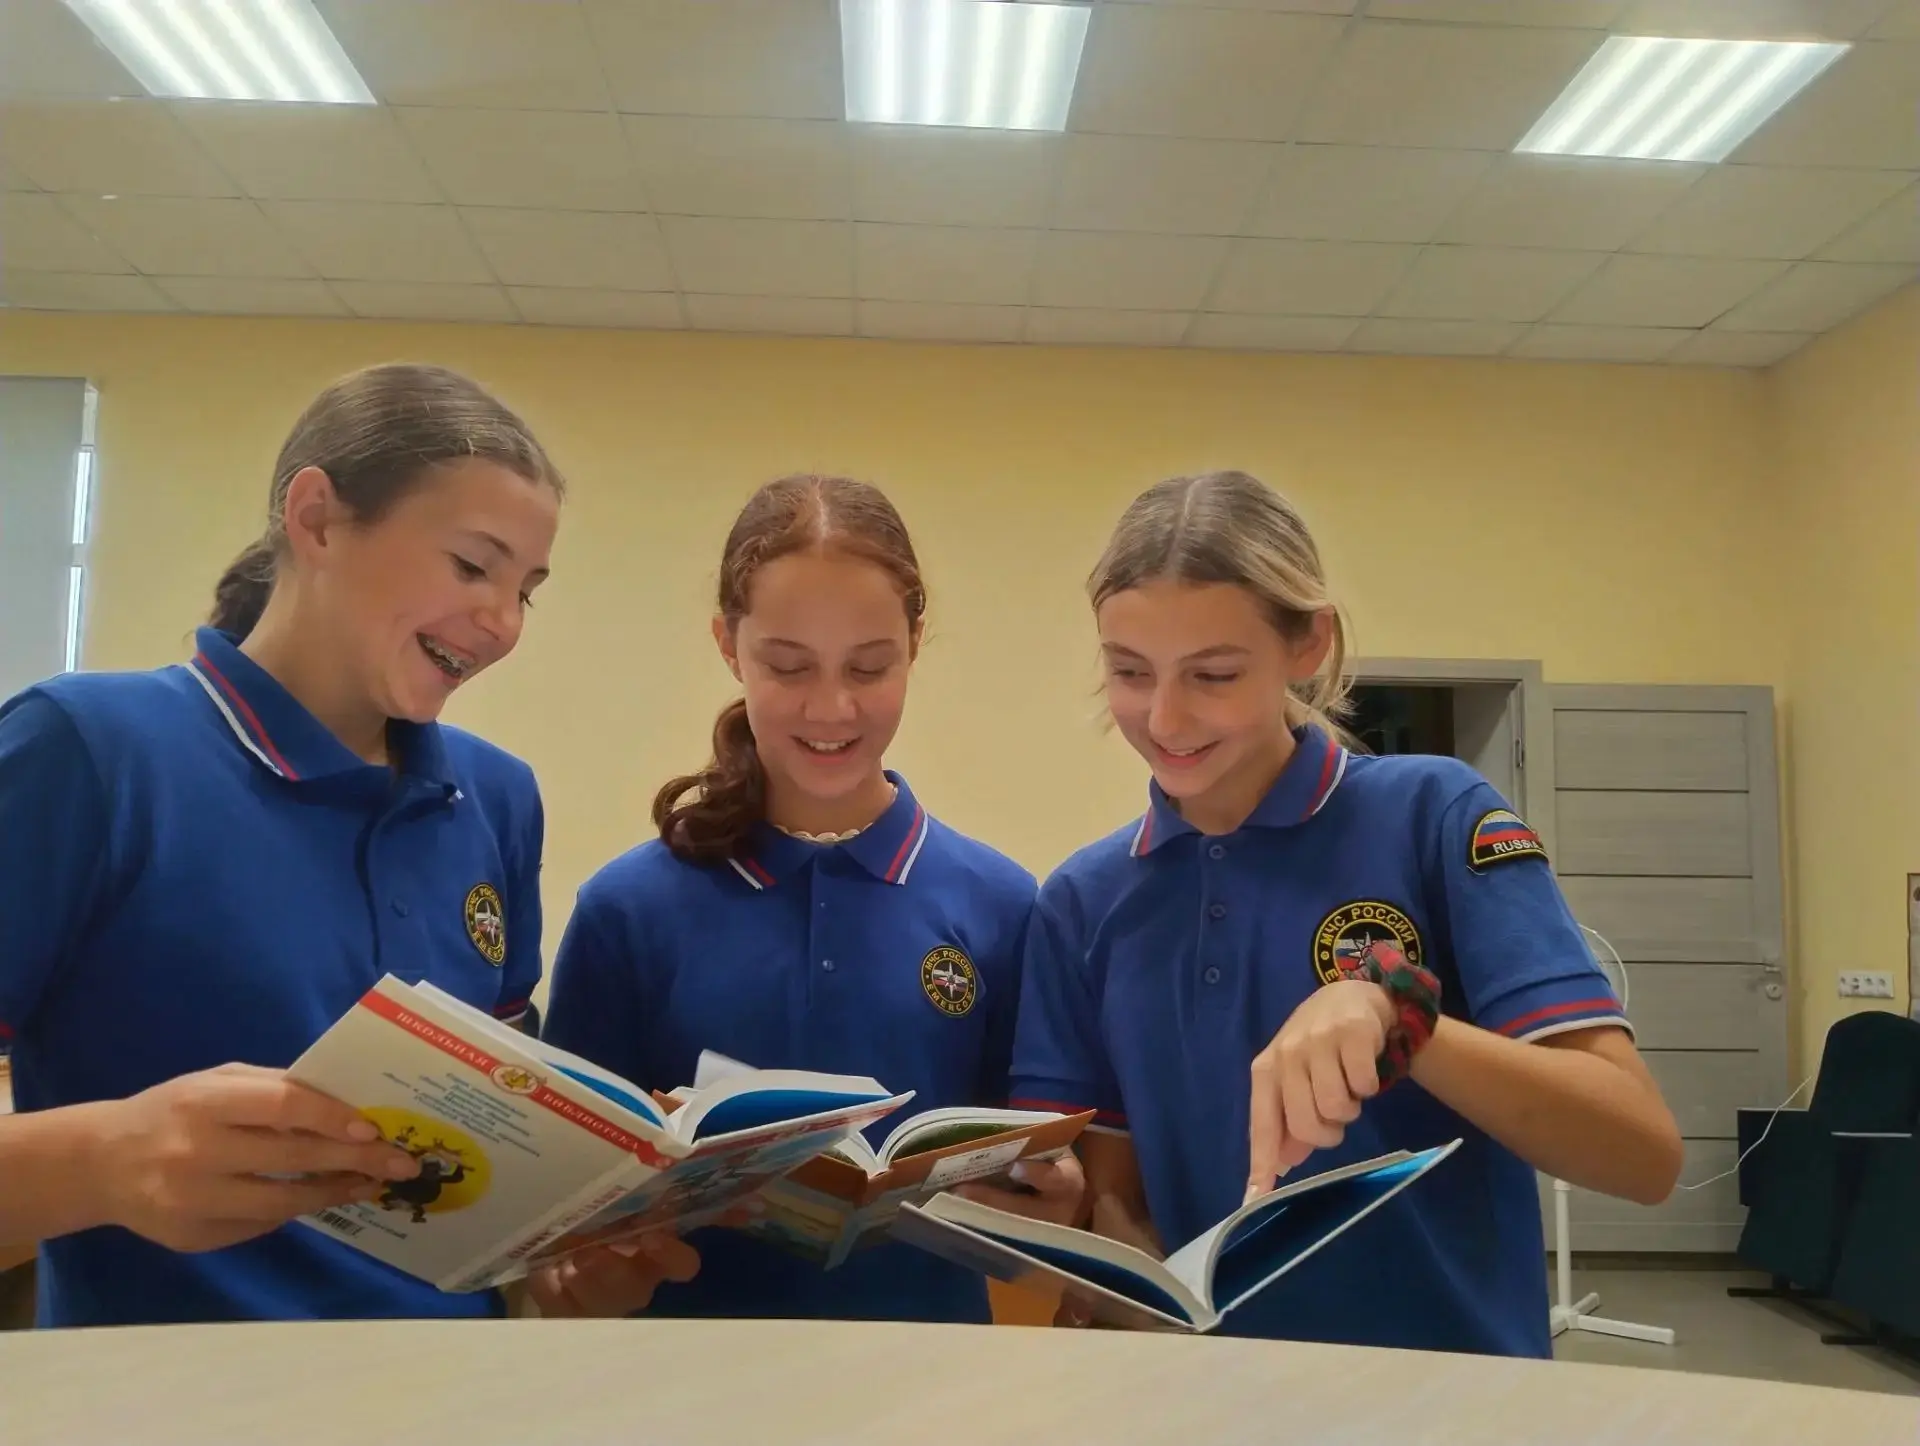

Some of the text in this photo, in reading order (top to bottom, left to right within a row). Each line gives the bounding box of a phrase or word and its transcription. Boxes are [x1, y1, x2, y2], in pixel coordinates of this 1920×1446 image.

[1320, 906, 1415, 946] МЧС РОССИИ
[925, 950, 973, 979] МЧС РОССИИ
[396, 1011, 489, 1067] ШКОЛЬНАЯ
[542, 1092, 640, 1151] БИБЛИОТЕКА
